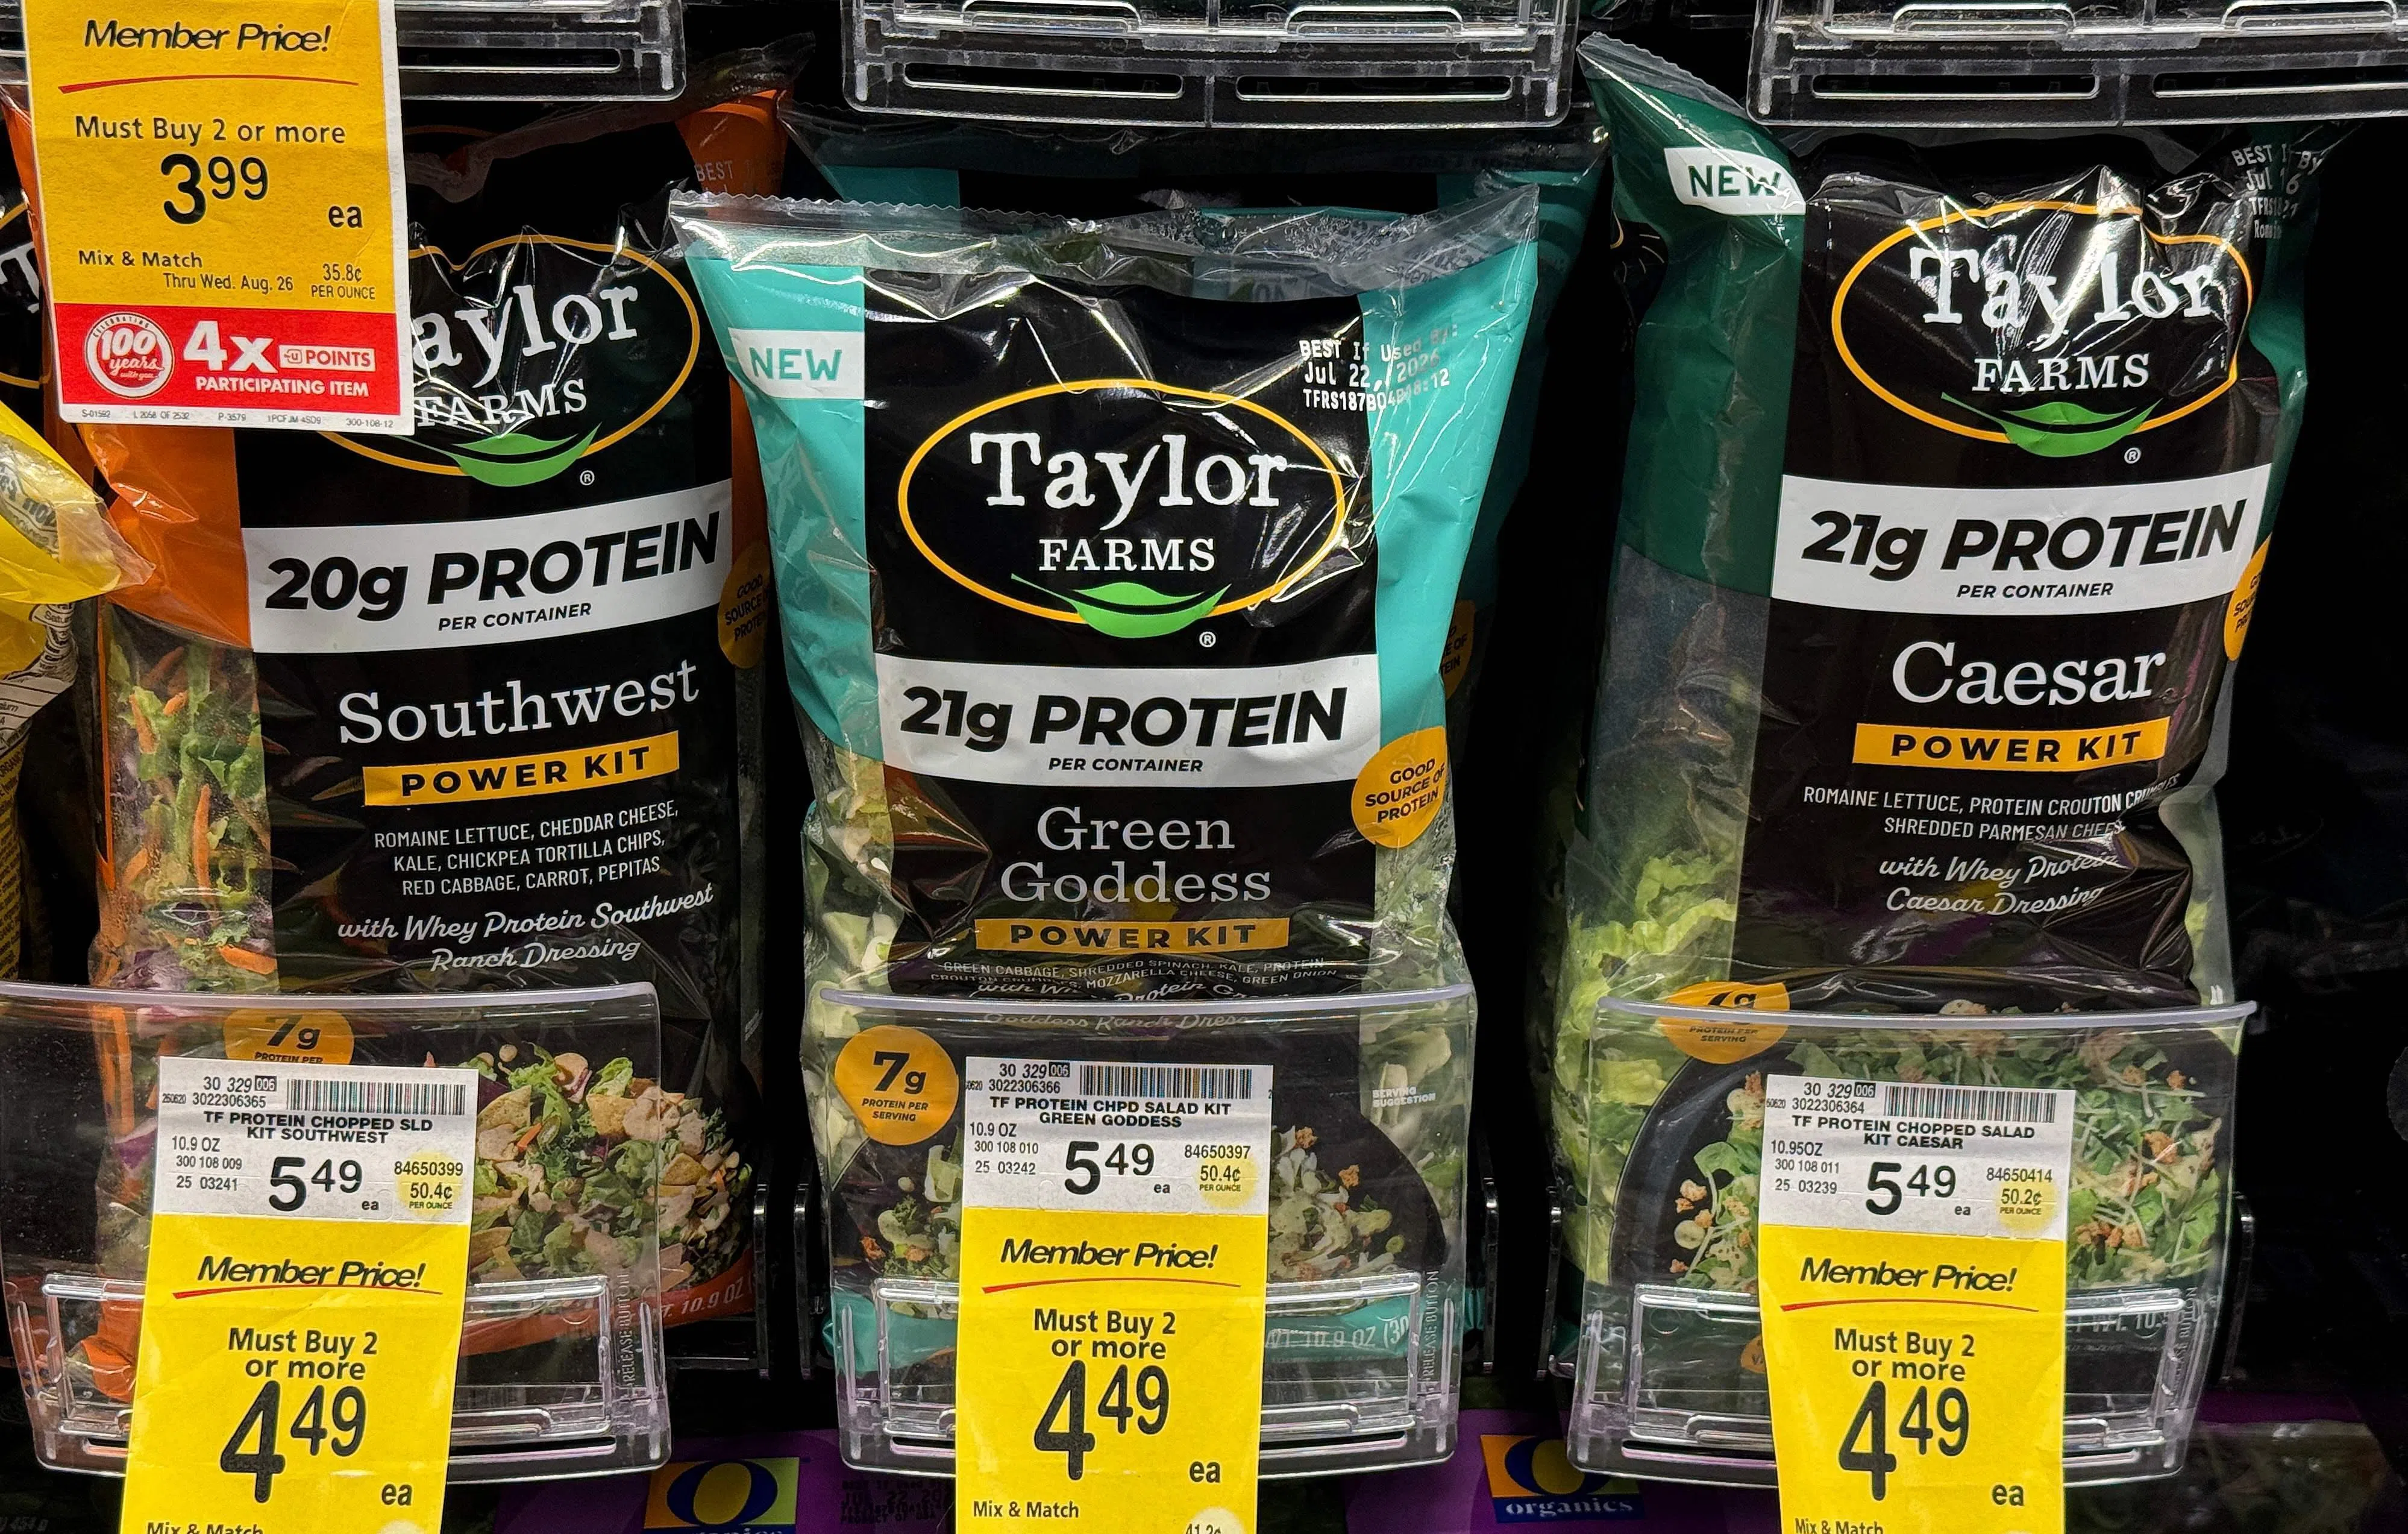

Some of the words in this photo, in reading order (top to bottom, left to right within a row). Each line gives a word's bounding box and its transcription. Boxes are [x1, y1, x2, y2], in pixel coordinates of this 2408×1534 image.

[85, 20, 229, 50] Member
[237, 24, 331, 52] Price!
[77, 116, 142, 139] Must
[154, 118, 202, 146] Buy
[213, 119, 227, 142] 2
[237, 125, 265, 142] or
[276, 126, 345, 143] more
[2231, 144, 2273, 167] BEST
[697, 160, 733, 183] BEST
[1688, 165, 1782, 198] NEW
[2246, 166, 2273, 190] Jul
[328, 205, 363, 228] ea
[79, 251, 113, 266] Mix
[122, 252, 135, 266] &
[142, 252, 202, 268] Match
[163, 272, 197, 289] Thru
[201, 274, 236, 289] Wed.
[241, 275, 272, 294] Aug.
[277, 277, 293, 291] 26
[322, 263, 362, 283] 35.8¢
[311, 286, 334, 299] PER
[337, 286, 375, 300] OUNCE
[1909, 236, 2215, 353] Taylor
[101, 327, 156, 360] 100
[1299, 339, 1341, 360] BEST
[1353, 341, 1370, 361] If
[1381, 337, 1422, 362] Used
[110, 356, 164, 376] years
[306, 350, 371, 367] POINTS
[749, 347, 842, 381] NEW
[1305, 362, 1337, 385] Jul
[1972, 353, 2149, 394] FARMS
[196, 376, 325, 394] PARTICIPATING
[329, 382, 369, 397] ITEM
[415, 378, 587, 427] FARMS
[970, 430, 1287, 531] Taylor
[265, 556, 408, 621] 20g
[427, 511, 721, 604] PROTEIN
[1039, 537, 1215, 572] FARMS
[439, 613, 479, 632] PER
[483, 602, 592, 629] CONTAINER
[1892, 640, 2166, 706] Caesar
[339, 660, 700, 744] Southwest
[900, 685, 1013, 752] 21g
[1029, 687, 1347, 747] PROTEIN
[401, 760, 567, 797] POWER
[585, 746, 650, 779] KIT
[1389, 758, 1436, 784] GOOD
[1365, 779, 1428, 807] SOURCE
[1423, 764, 1445, 787] OF
[1376, 790, 1439, 823] PROTEIN
[1804, 786, 1878, 808] ROMAINE
[1883, 791, 1963, 815] LETTUCE,
[1969, 796, 2043, 817] PROTEIN
[2048, 794, 2122, 816] CROUTON
[375, 829, 450, 849] ROMAINE
[455, 823, 535, 845] LETTUCE,
[541, 813, 613, 837] CHEDDAR
[618, 799, 678, 827] CHEESE,
[1038, 806, 1235, 850] Green
[1884, 817, 1974, 838] SHREDDED
[1978, 821, 2068, 843] PARMESAN
[393, 855, 442, 873] KALE,
[447, 846, 530, 871] CHICKPEA
[535, 840, 613, 864] TORTILLA
[616, 829, 665, 855] CHIPS,
[402, 879, 435, 896] RED
[441, 874, 521, 895] CABBAGE,
[525, 868, 593, 890] CARROT,
[598, 857, 660, 882] PEPITAS
[1001, 860, 1271, 904] Goddess
[338, 919, 398, 938] with
[403, 914, 477, 945] Whey
[484, 908, 585, 938] Protein
[591, 883, 715, 929] Southwest
[431, 948, 516, 972] Ranch
[520, 938, 642, 968] Dressing
[943, 961, 991, 974] GREEN
[995, 964, 1065, 978] CABBAGE,
[1068, 961, 1144, 978] SHREDDED
[1263, 958, 1325, 973] PROTEIN
[1086, 969, 1174, 989] MOZZARELLA
[1243, 971, 1290, 985] GREEN
[1293, 969, 1337, 979] ONION
[266, 1014, 321, 1050] 7g
[1701, 1034, 1746, 1043] SERVING
[255, 1052, 299, 1062] PROTEIN
[204, 1077, 221, 1090] 30
[227, 1078, 252, 1093] 329
[256, 1076, 277, 1092] 006
[873, 1051, 926, 1095] 7g
[988, 1079, 1061, 1094] 3022306366
[192, 1093, 266, 1109] 3022306365
[862, 1098, 907, 1110] PROTEIN
[909, 1101, 929, 1111] PER
[989, 1096, 1009, 1109] TF
[1015, 1098, 1088, 1111] PROTEIN
[1093, 1099, 1139, 1113] CHPD
[1144, 1101, 1199, 1115] SALAD
[1205, 1102, 1231, 1115] KIT
[1792, 1098, 1865, 1114] 3022306364
[204, 1111, 224, 1124] TF
[230, 1113, 306, 1127] PROTEIN
[312, 1116, 394, 1131] CHOPPED
[400, 1119, 433, 1132] SLD
[872, 1110, 916, 1122] SERVING
[1039, 1112, 1096, 1126] GREEN
[1102, 1114, 1182, 1128] GODDESS
[1792, 1115, 1812, 1128] TF
[1817, 1116, 1890, 1132] PROTEIN
[1896, 1119, 1976, 1136] CHOPPED
[1981, 1124, 2036, 1139] SALAD
[172, 1137, 198, 1152] 10.9
[201, 1138, 221, 1152] OZ
[246, 1127, 275, 1140] KIT
[281, 1129, 389, 1144] SOUTHWEST
[1863, 1133, 1890, 1146] KIT
[1896, 1134, 1963, 1149] CAESAR
[1184, 1145, 1251, 1160] 84650397
[1771, 1140, 1823, 1157] 10.95OZ
[393, 1161, 463, 1176] 84650399
[975, 1161, 989, 1174] 25
[998, 1161, 1036, 1175] 03242
[1200, 1165, 1241, 1182] 50.4¢
[1986, 1167, 2052, 1183] 84650414
[410, 1183, 453, 1201] 50.4¢
[2001, 1189, 2042, 1207] 50.2¢
[681, 1291, 720, 1314] 10.9
[228, 1327, 296, 1353] Must
[305, 1330, 356, 1361] Buy
[364, 1333, 378, 1356] 2
[618, 1330, 636, 1382] RELEASE
[245, 1358, 277, 1378] or
[288, 1361, 366, 1381] more
[973, 1501, 1003, 1518] Mix
[1008, 1501, 1021, 1518] &
[1026, 1501, 1079, 1519] Match
[1505, 1498, 1634, 1518] organics
